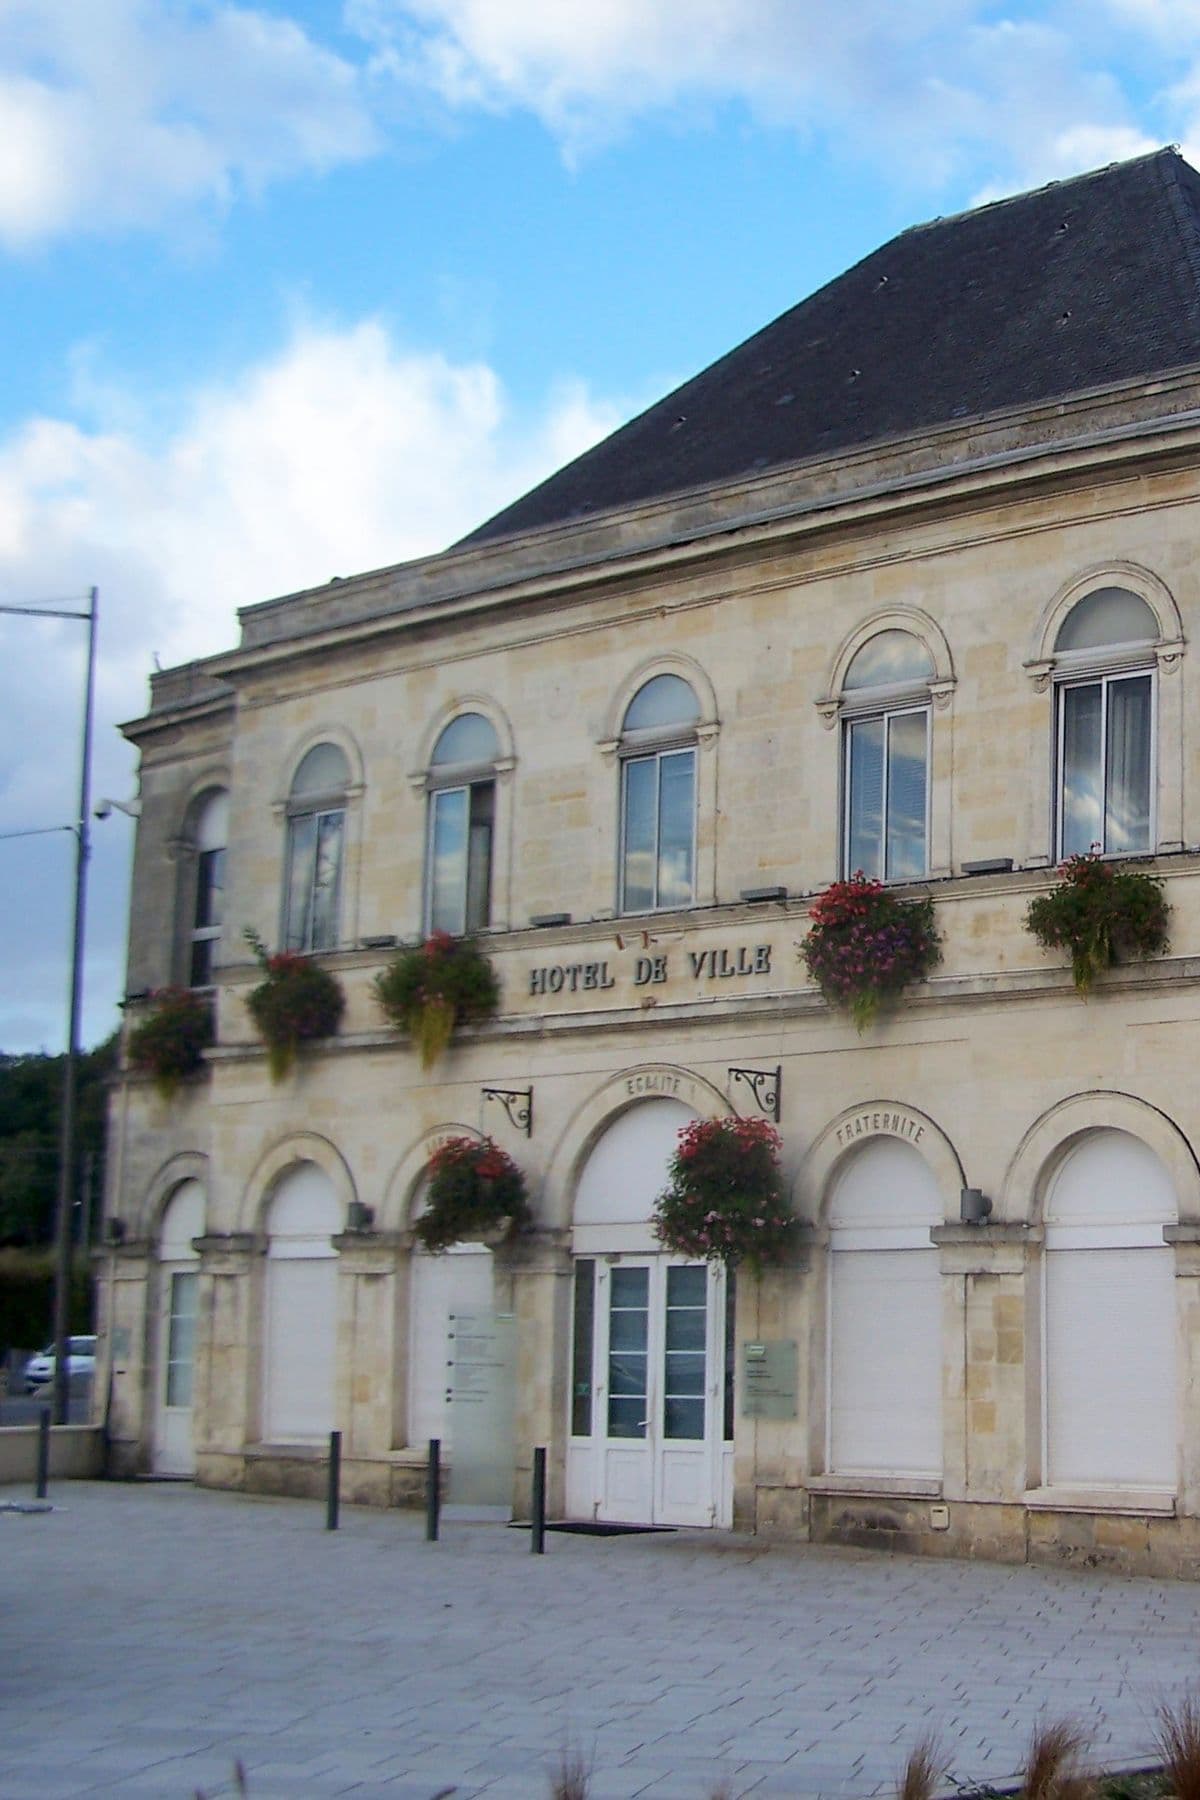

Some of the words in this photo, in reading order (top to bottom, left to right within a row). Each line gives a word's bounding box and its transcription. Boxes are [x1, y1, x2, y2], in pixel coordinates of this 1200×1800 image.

[529, 962, 615, 995] HOTEL
[634, 955, 667, 985] DE
[689, 945, 772, 979] VILLE
[836, 1113, 925, 1145] FRATERNITE
